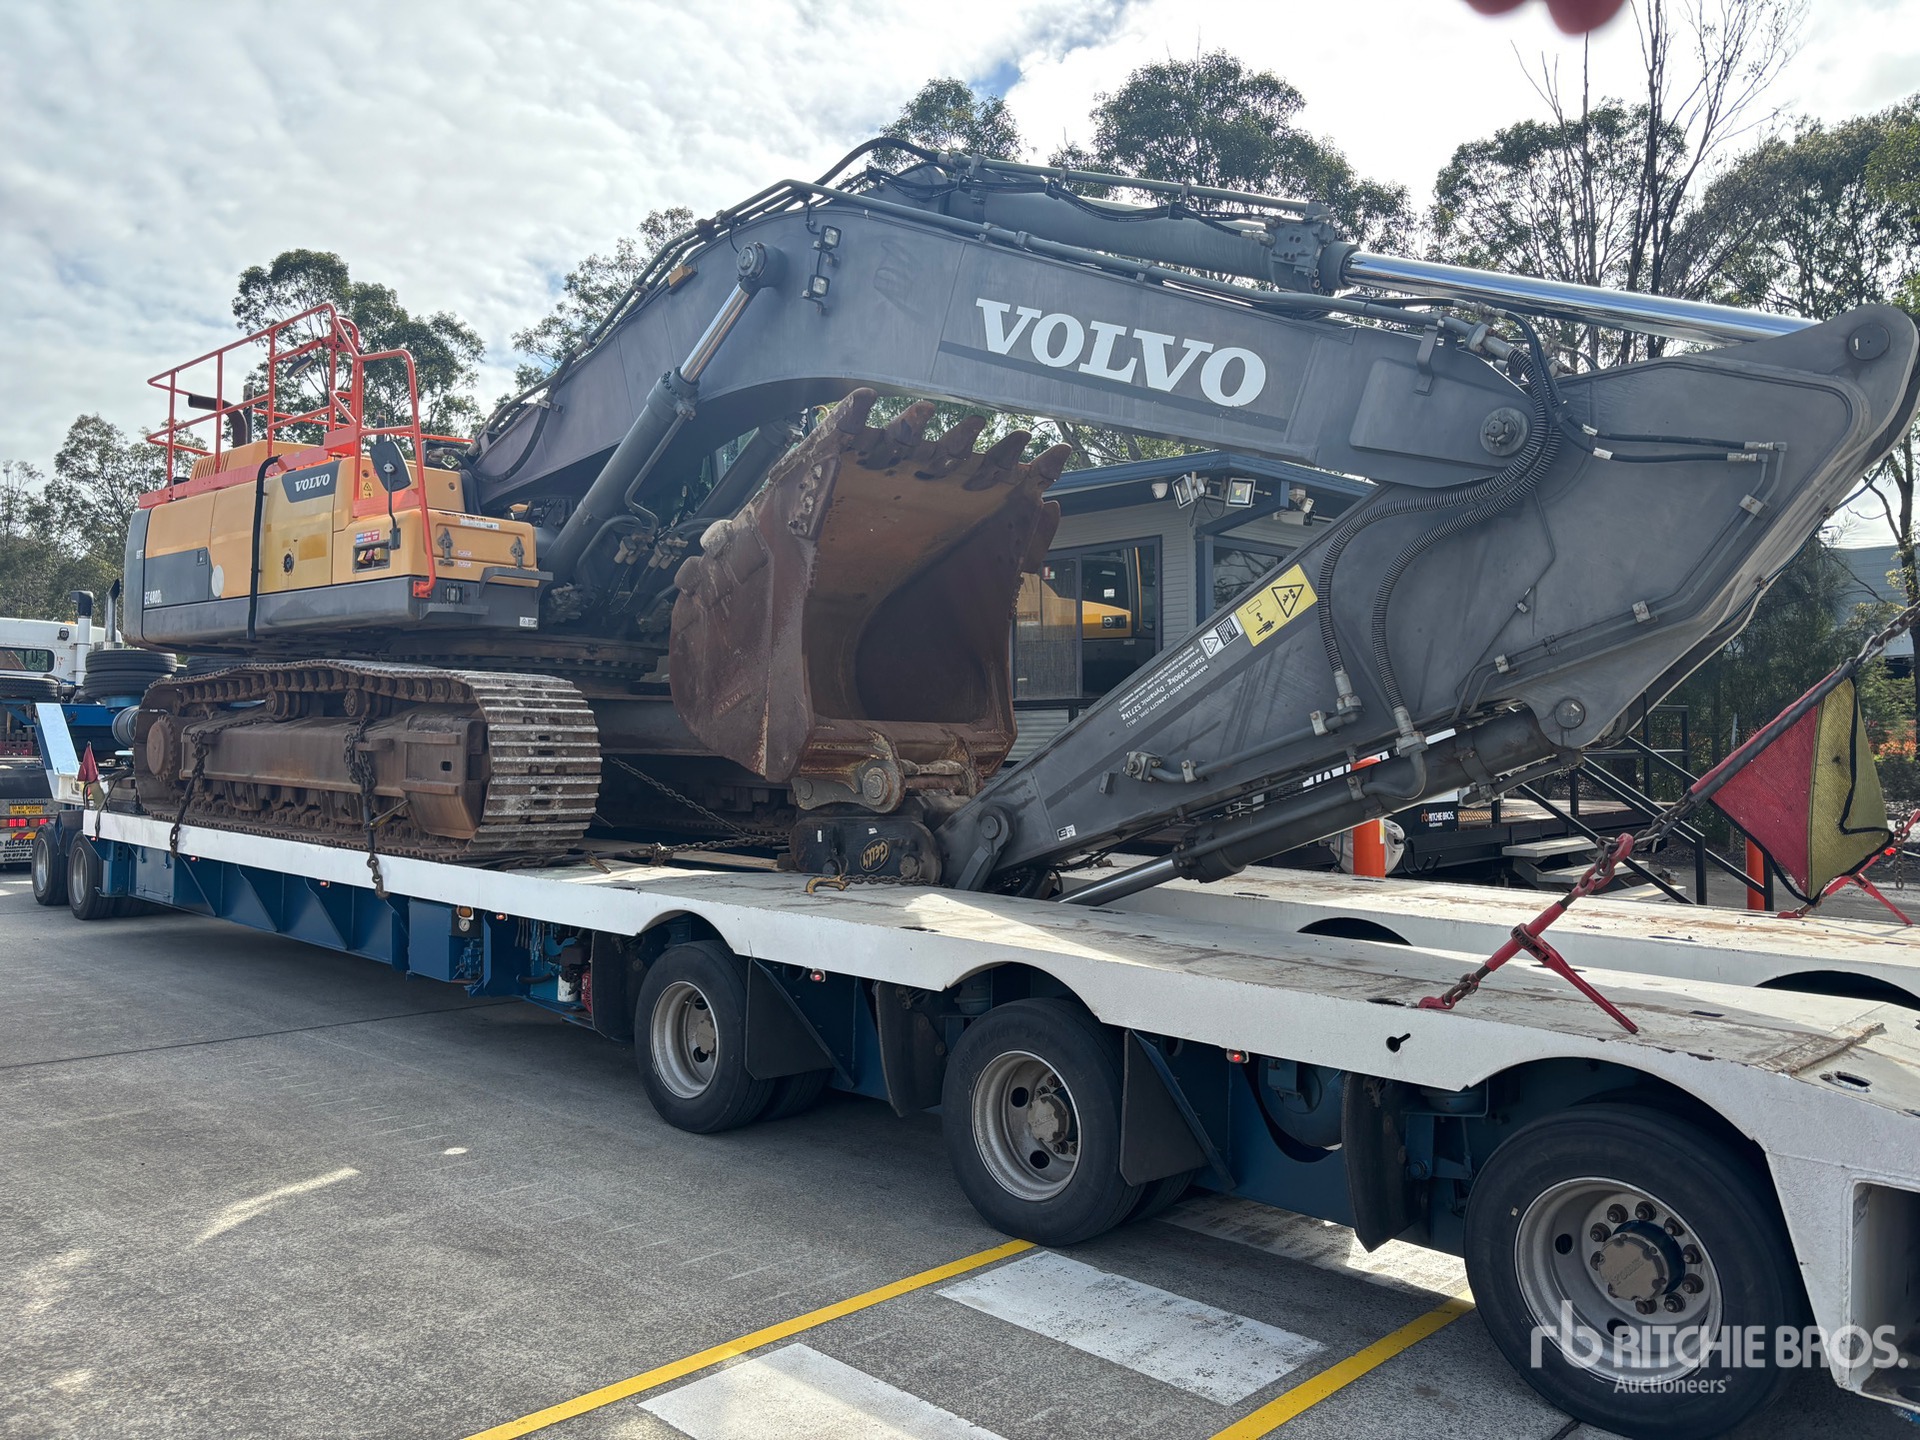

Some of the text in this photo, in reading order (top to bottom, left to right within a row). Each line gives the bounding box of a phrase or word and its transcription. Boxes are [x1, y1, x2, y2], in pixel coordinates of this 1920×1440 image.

[976, 298, 1266, 408] VOLVO
[294, 473, 331, 492] VOLVO
[1188, 655, 1205, 670] Static
[1167, 667, 1189, 685] 5990kg
[1183, 664, 1208, 685] MAXIMUM
[1140, 685, 1165, 706] Dynamic
